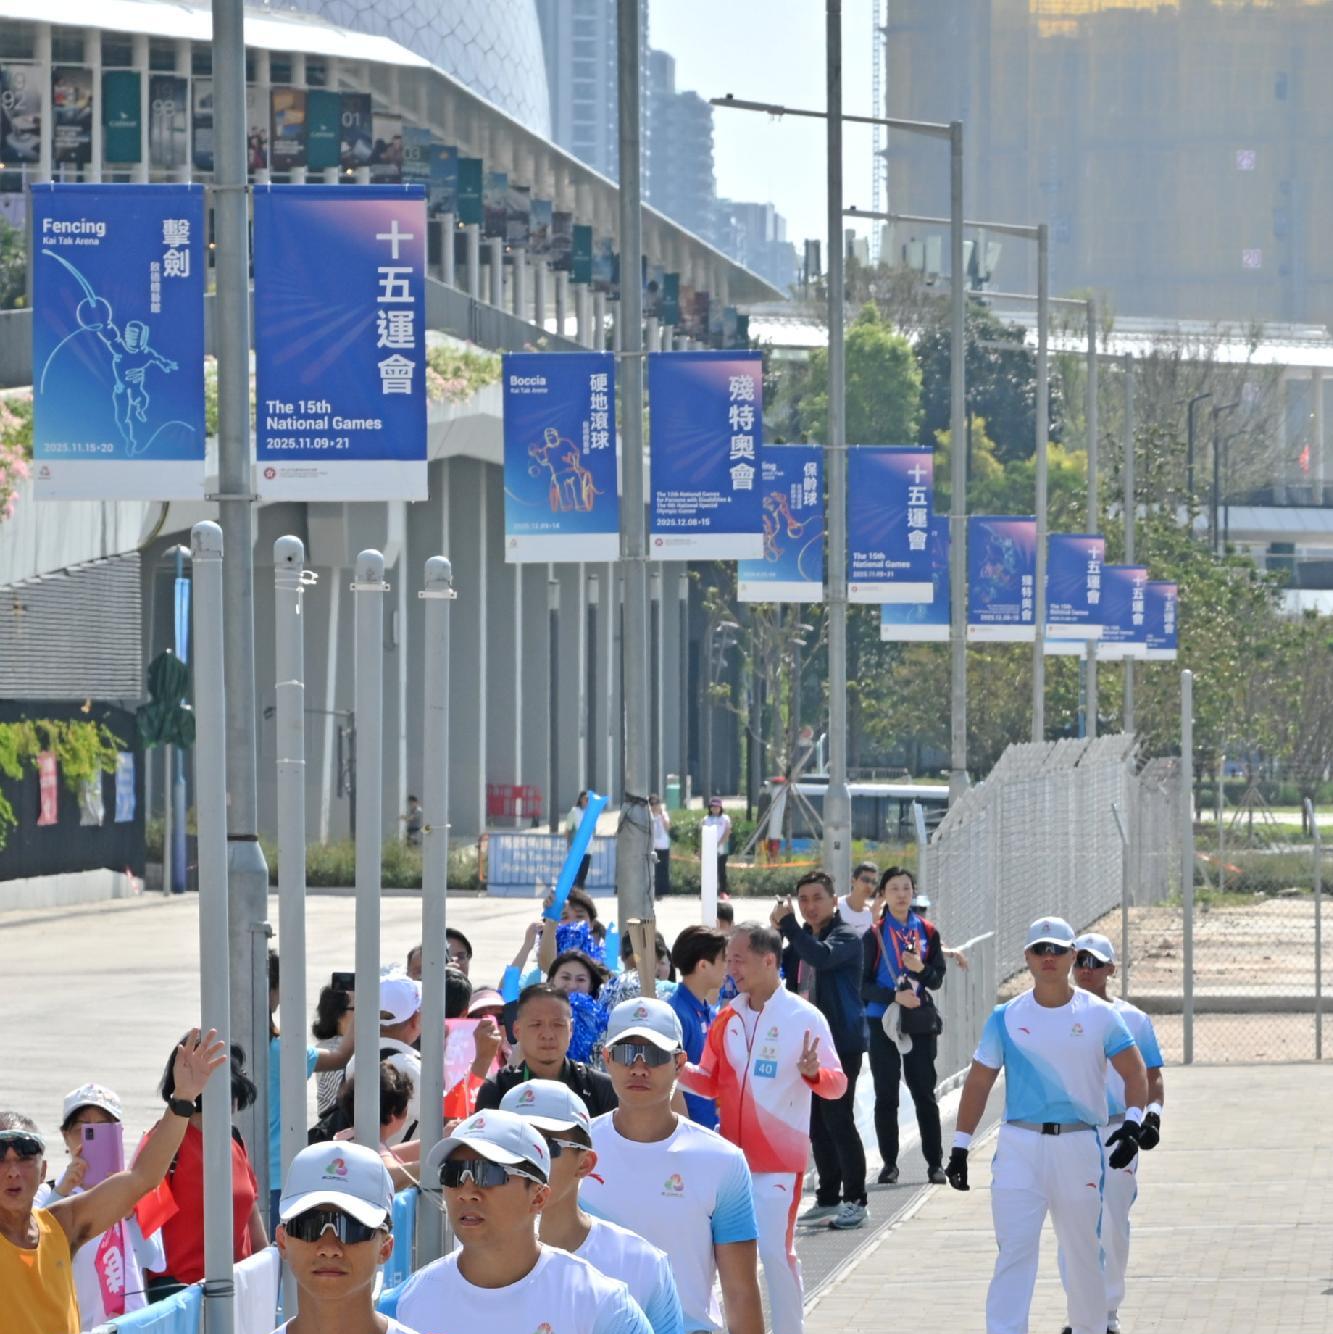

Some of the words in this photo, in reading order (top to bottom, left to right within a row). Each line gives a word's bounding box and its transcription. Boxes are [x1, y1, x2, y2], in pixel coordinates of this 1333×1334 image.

[341, 112, 360, 128] 01
[42, 218, 107, 237] Fencing
[43, 237, 56, 245] Kai
[58, 237, 73, 245] Tak
[75, 237, 100, 245] Arena
[162, 219, 190, 278] 擊劍
[375, 220, 416, 396] 十五運會
[510, 374, 547, 386] Boccia
[266, 400, 293, 414] The
[298, 400, 331, 414] 15th
[589, 373, 610, 450] 硬地滾球
[266, 416, 329, 430] National
[332, 416, 383, 430] Games
[728, 374, 756, 491] 殘特奧會
[907, 464, 928, 551] 十五運會
[853, 560, 883, 568] National
[885, 560, 911, 568] Games
[1087, 545, 1101, 605] 十五運會
[1132, 577, 1144, 626] 十五運會
[759, 1064, 773, 1074] 40
